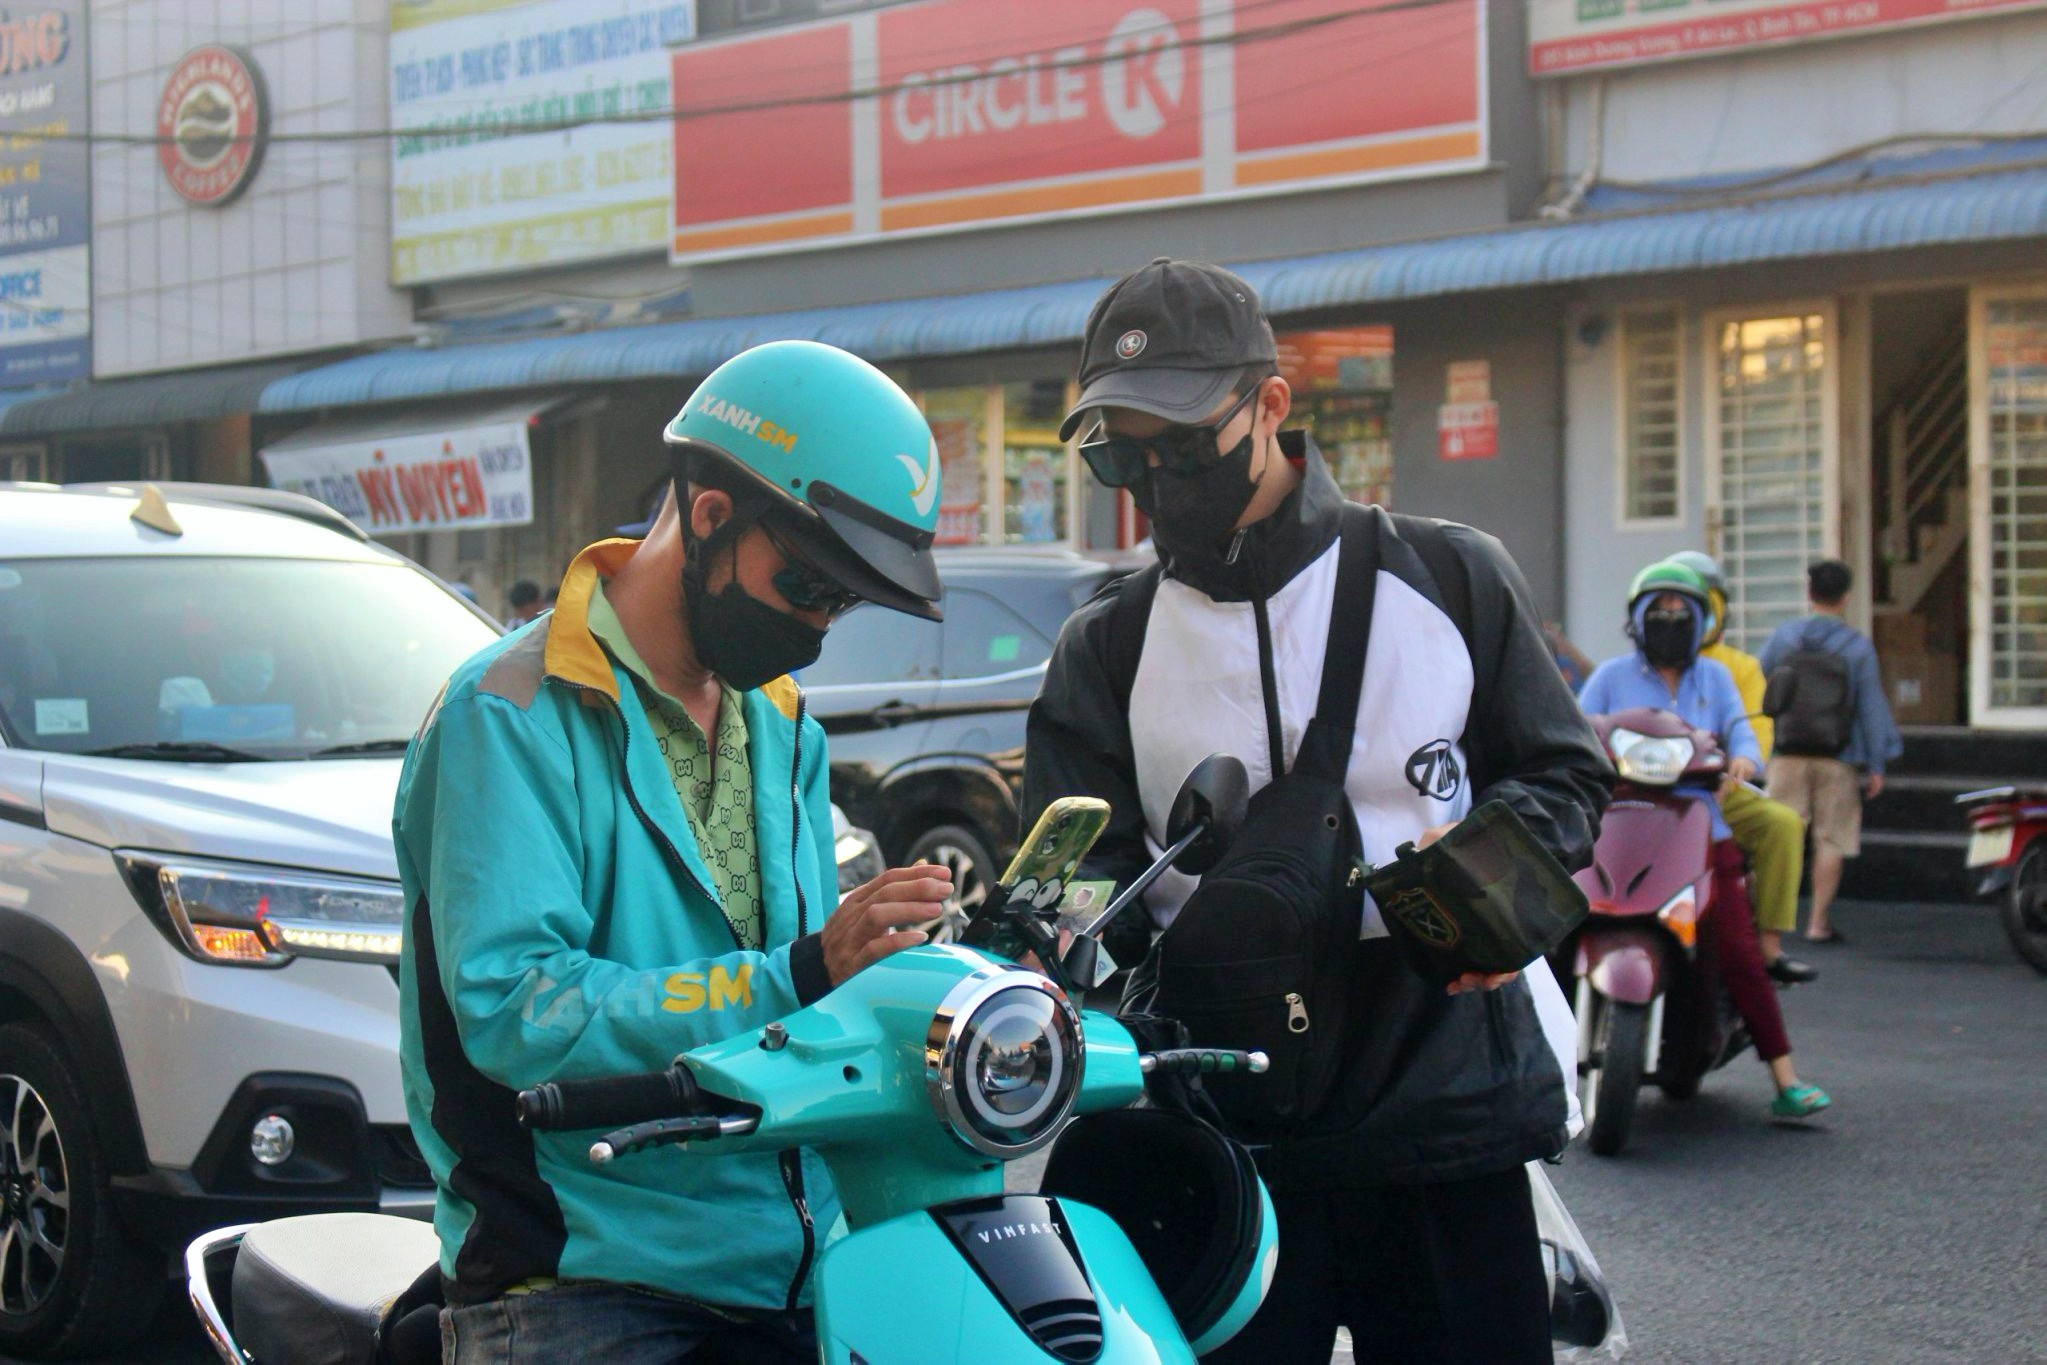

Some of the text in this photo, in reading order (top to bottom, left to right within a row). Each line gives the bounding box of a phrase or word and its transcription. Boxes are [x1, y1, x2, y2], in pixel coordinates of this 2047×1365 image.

[894, 8, 1184, 143] CIRCLE K
[698, 395, 798, 454] XANH SM
[661, 965, 754, 1014] SM
[978, 1222, 1062, 1244] VINFAST
